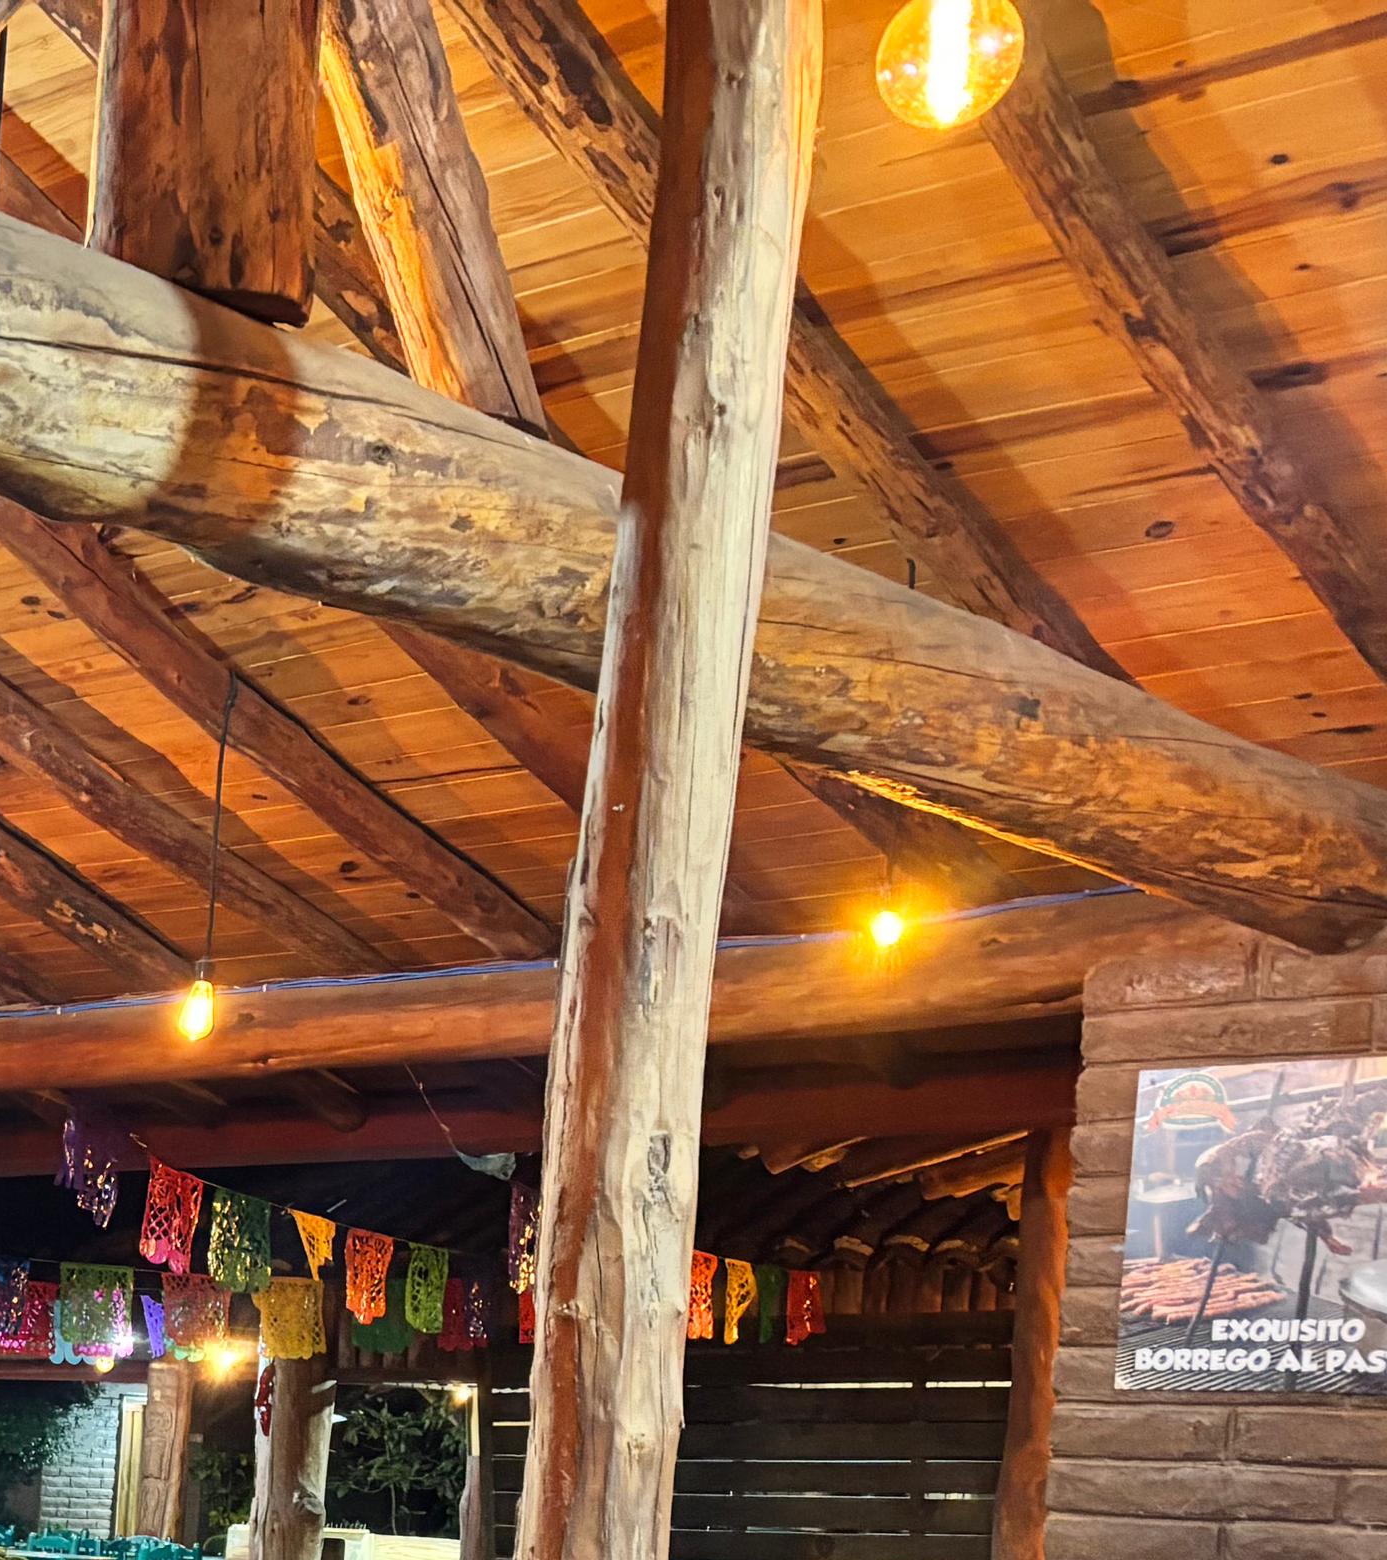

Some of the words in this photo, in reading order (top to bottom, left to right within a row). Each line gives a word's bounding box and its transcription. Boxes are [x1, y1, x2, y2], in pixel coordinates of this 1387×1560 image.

[1211, 1318, 1366, 1343] EXQUISITO
[1134, 1348, 1271, 1372] BORREGO
[1275, 1349, 1318, 1373] AL
[1325, 1348, 1387, 1374] PAS
